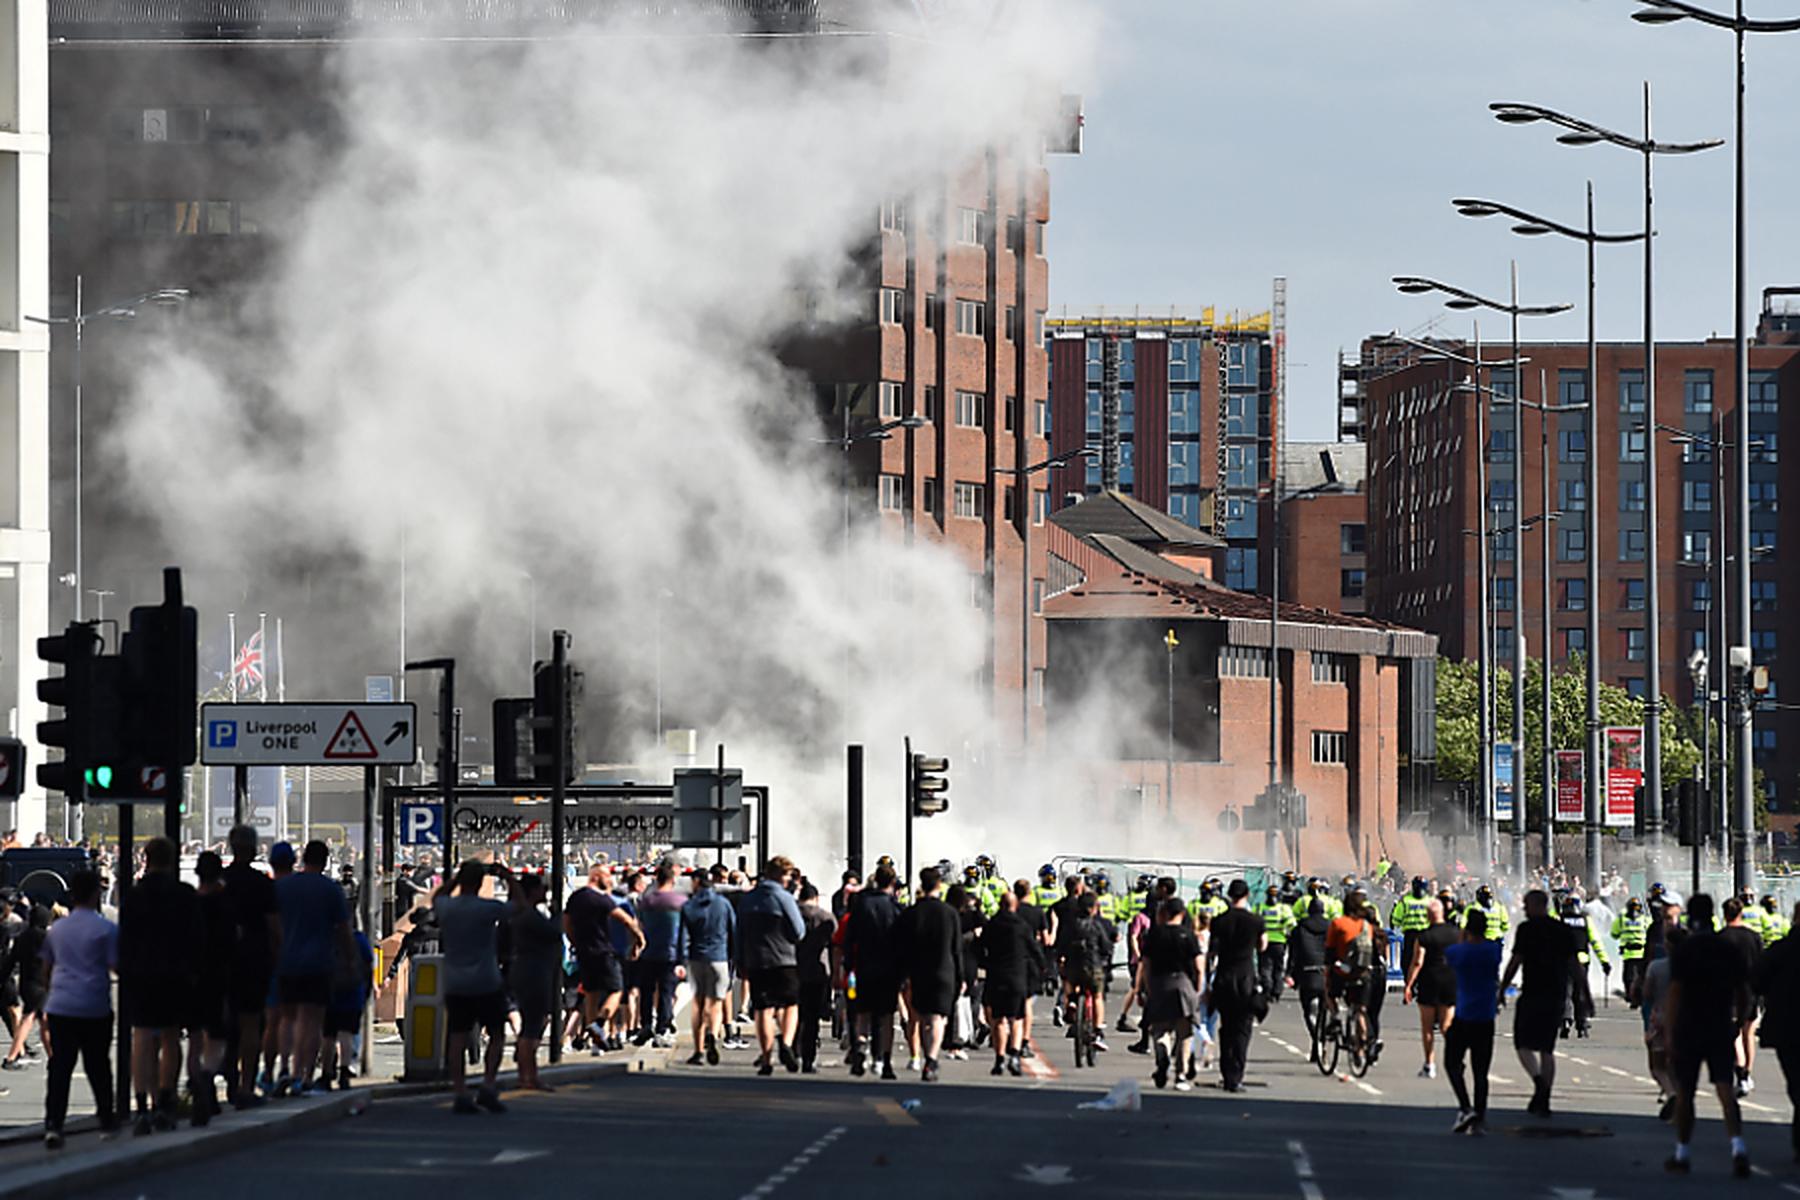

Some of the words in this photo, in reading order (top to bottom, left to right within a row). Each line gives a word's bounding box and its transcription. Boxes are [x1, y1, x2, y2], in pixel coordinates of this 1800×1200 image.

[215, 724, 231, 746] P
[246, 721, 317, 735] Liverpool
[262, 737, 299, 749] ONE
[408, 807, 434, 843] P
[565, 815, 648, 830] VERPOOL
